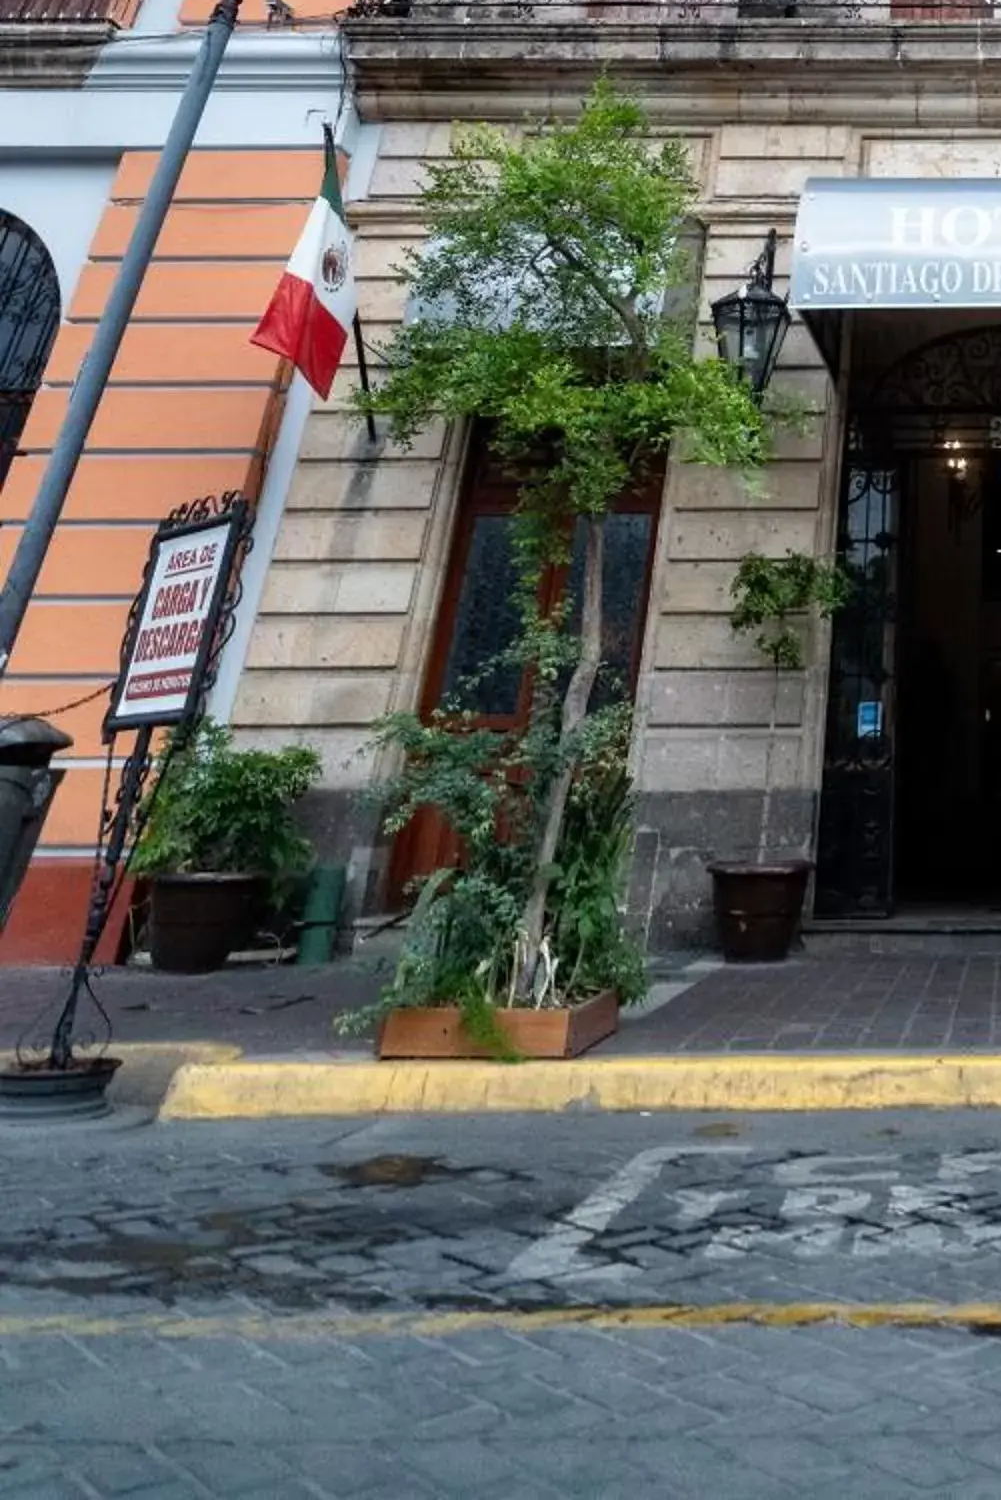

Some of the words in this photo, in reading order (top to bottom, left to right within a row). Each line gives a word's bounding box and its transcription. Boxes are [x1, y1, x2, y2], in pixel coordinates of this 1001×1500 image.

[812, 262, 963, 296] SANTIAGO
[200, 543, 217, 564] DE
[152, 580, 200, 621] CARGA
[199, 576, 213, 610] Y
